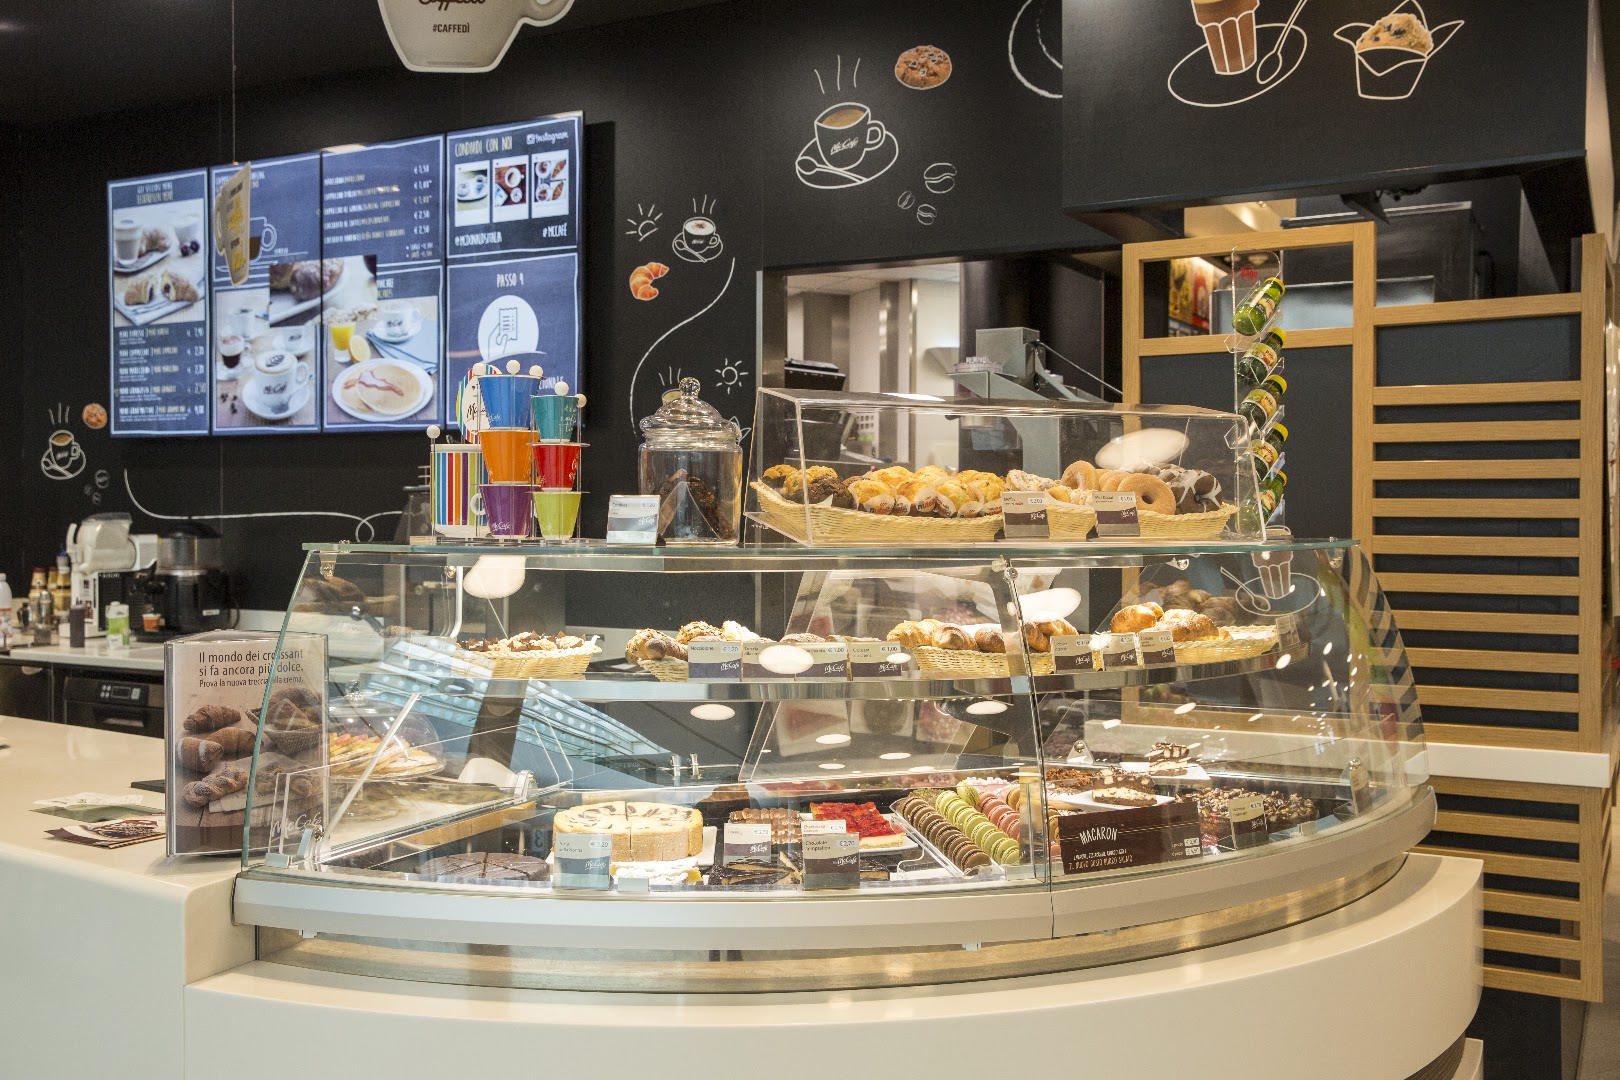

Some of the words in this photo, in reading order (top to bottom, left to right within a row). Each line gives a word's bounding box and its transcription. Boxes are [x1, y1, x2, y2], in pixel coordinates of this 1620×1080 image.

[433, 22, 470, 33] #CAFFEDÌ
[485, 137, 499, 153] CON
[501, 135, 513, 150] NOI
[496, 273, 517, 287] PASSO
[199, 652, 205, 663] Il
[208, 651, 243, 662] mondo
[245, 650, 260, 661] dei
[199, 665, 207, 677] si
[210, 665, 219, 676] fa
[222, 666, 255, 676] ancora
[276, 661, 304, 673] dolce.
[199, 679, 218, 688] Prova
[219, 678, 225, 687] la
[226, 679, 247, 687] nuova
[248, 678, 269, 686] treccia
[1079, 826, 1118, 845] MACARON
